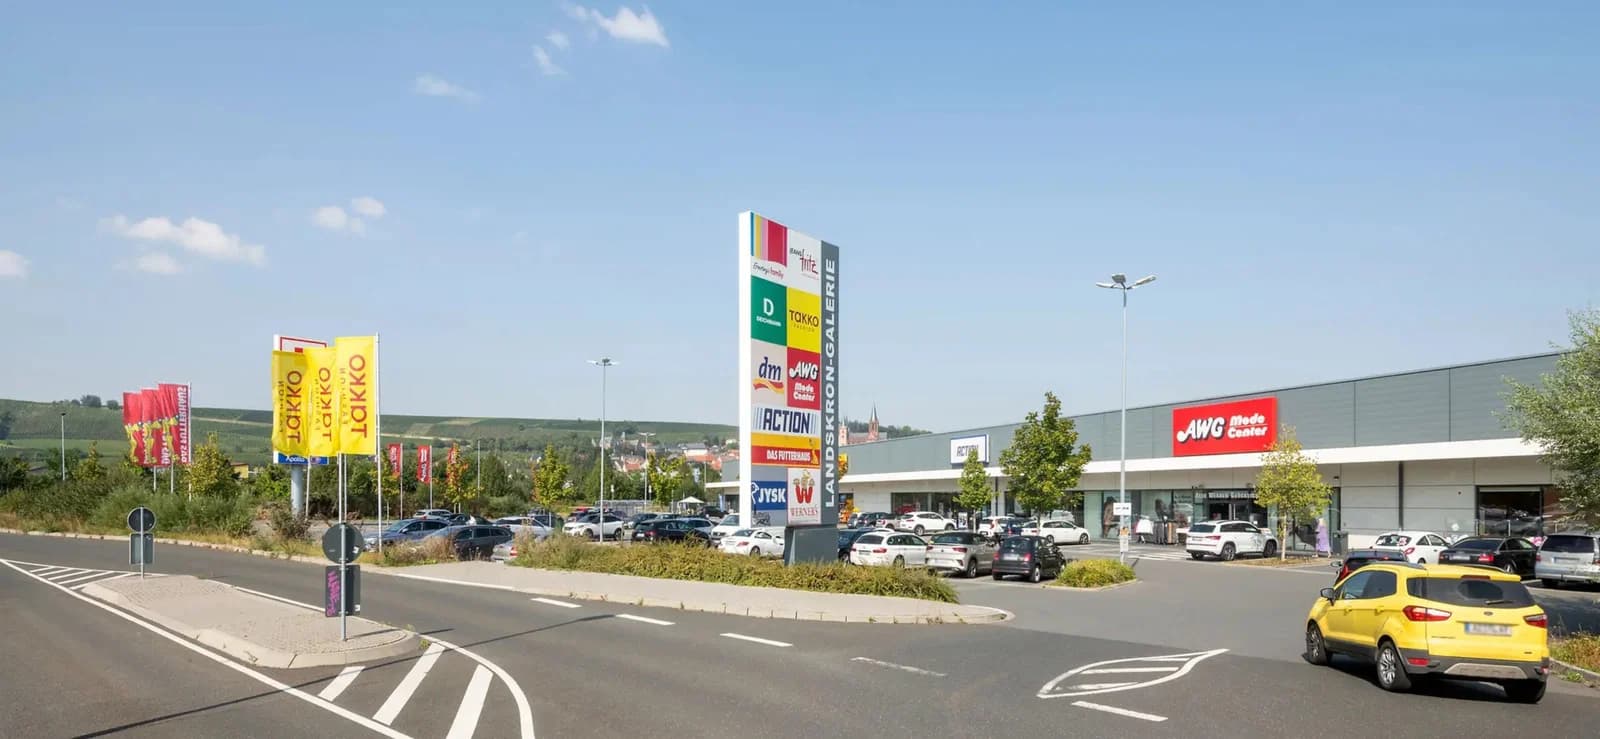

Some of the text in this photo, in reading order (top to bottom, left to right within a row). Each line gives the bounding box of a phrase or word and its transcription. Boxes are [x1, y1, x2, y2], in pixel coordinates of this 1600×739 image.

[763, 298, 774, 316] D
[758, 357, 782, 380] dm
[789, 361, 819, 380] AWG
[825, 259, 835, 508] LANDSKRON-GALERIE
[763, 408, 811, 434] ACTION
[1230, 413, 1264, 425] Mode
[1176, 417, 1225, 443] AWG
[1227, 426, 1268, 438] Center
[766, 450, 778, 460] DAS
[758, 488, 786, 503] JYSK
